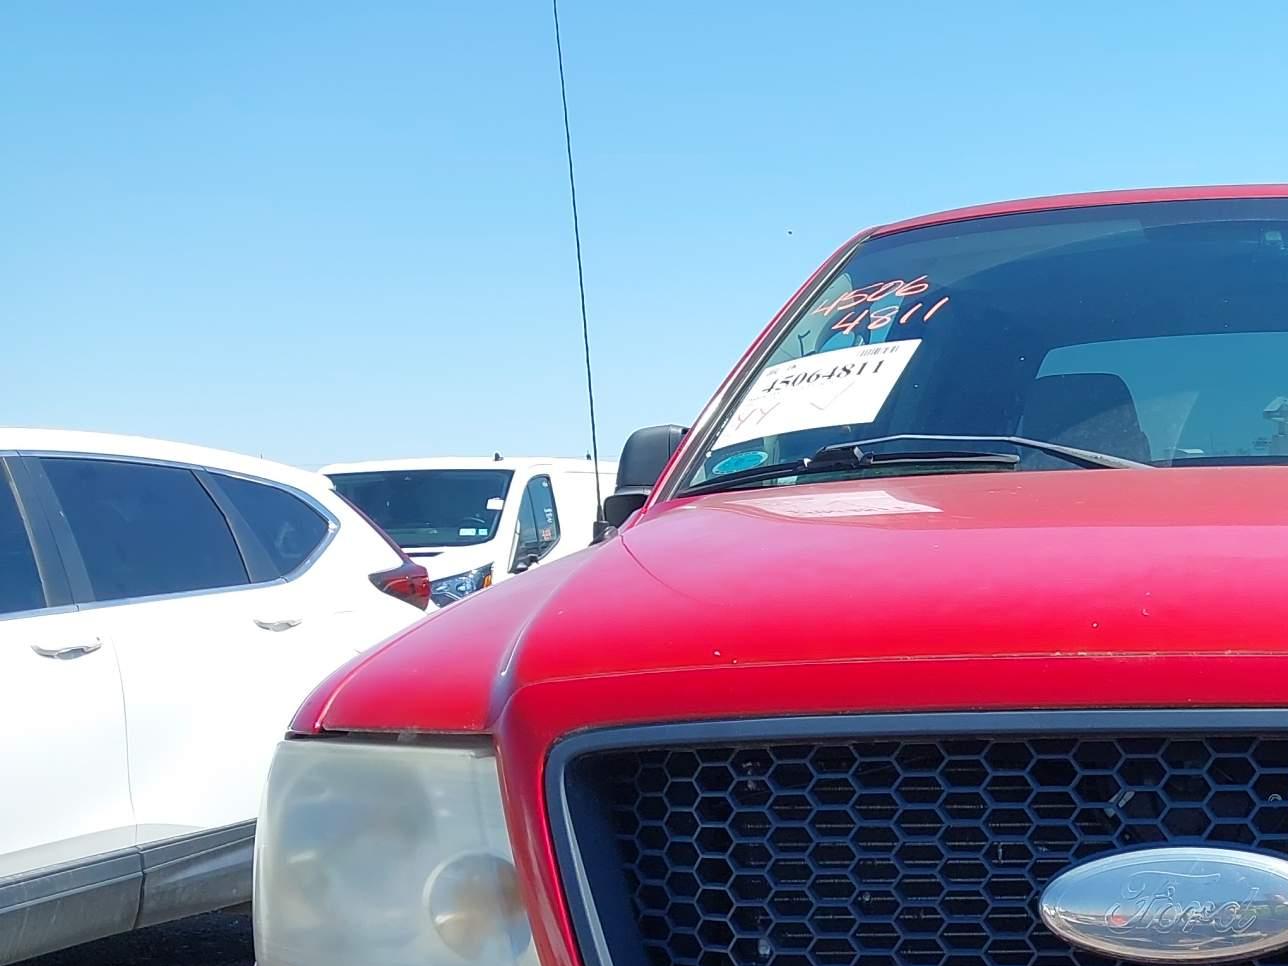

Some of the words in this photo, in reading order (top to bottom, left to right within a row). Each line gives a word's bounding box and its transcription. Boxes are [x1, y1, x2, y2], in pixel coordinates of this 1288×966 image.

[811, 274, 929, 316] 4506
[832, 297, 949, 335] 4811
[762, 359, 885, 394] 45064811
[1103, 869, 1261, 935] Ford
